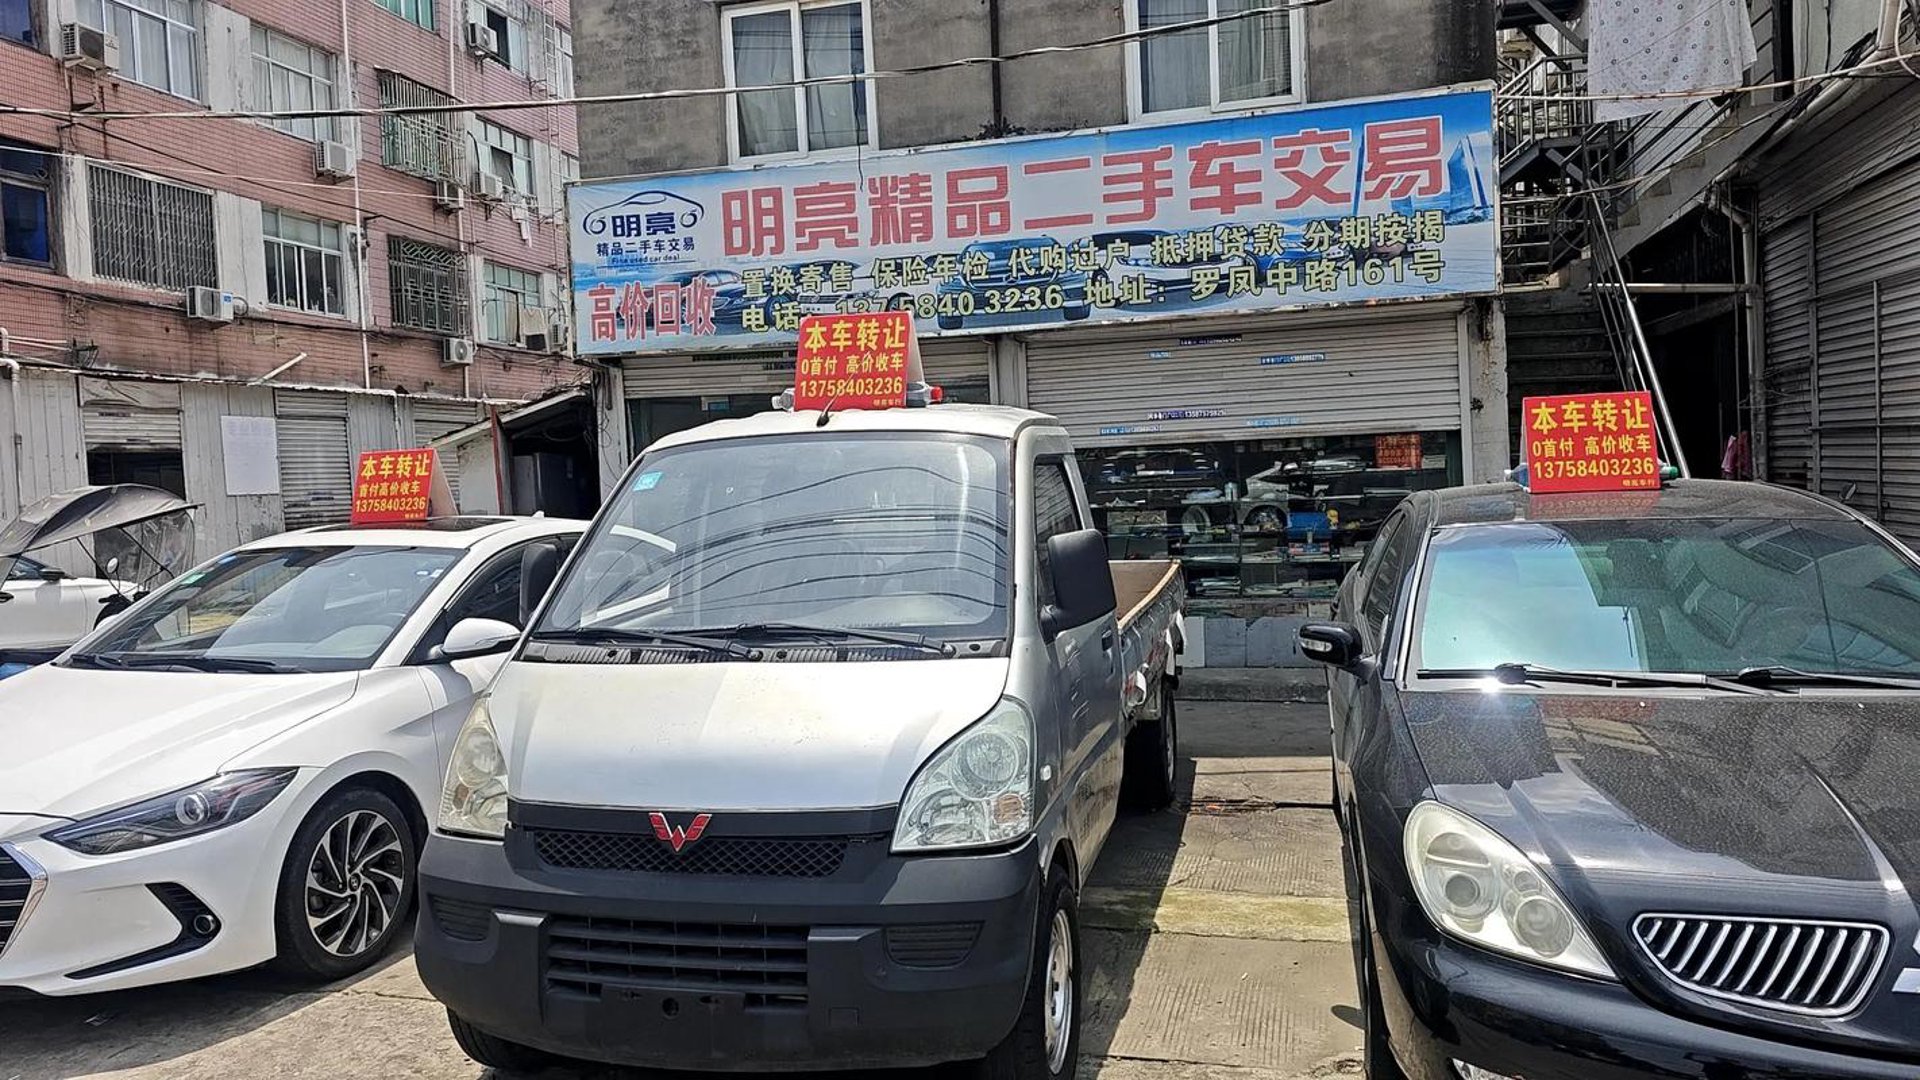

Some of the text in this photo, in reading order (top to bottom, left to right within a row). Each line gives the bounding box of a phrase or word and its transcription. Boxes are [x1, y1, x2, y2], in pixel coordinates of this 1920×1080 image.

[722, 117, 1444, 256] 明亮精品二手车交易
[611, 212, 676, 237] 明亮
[597, 237, 695, 256] 精品二手车交易
[741, 209, 1445, 298] 置换寄售 保险年检 代购过户 抵押贷款 分期按揭
[587, 276, 716, 342] 高价回收
[984, 283, 1064, 315] 3236
[804, 316, 906, 354] 本车转让
[800, 352, 904, 377] 0首付 高价收车
[800, 376, 903, 398] 13758403236
[1530, 397, 1651, 435] 本车转让
[1532, 432, 1652, 459] 0首付 高价收车
[360, 453, 431, 480] 本车转让
[1533, 457, 1655, 479] 13758403236
[355, 496, 426, 513] 13758403236
